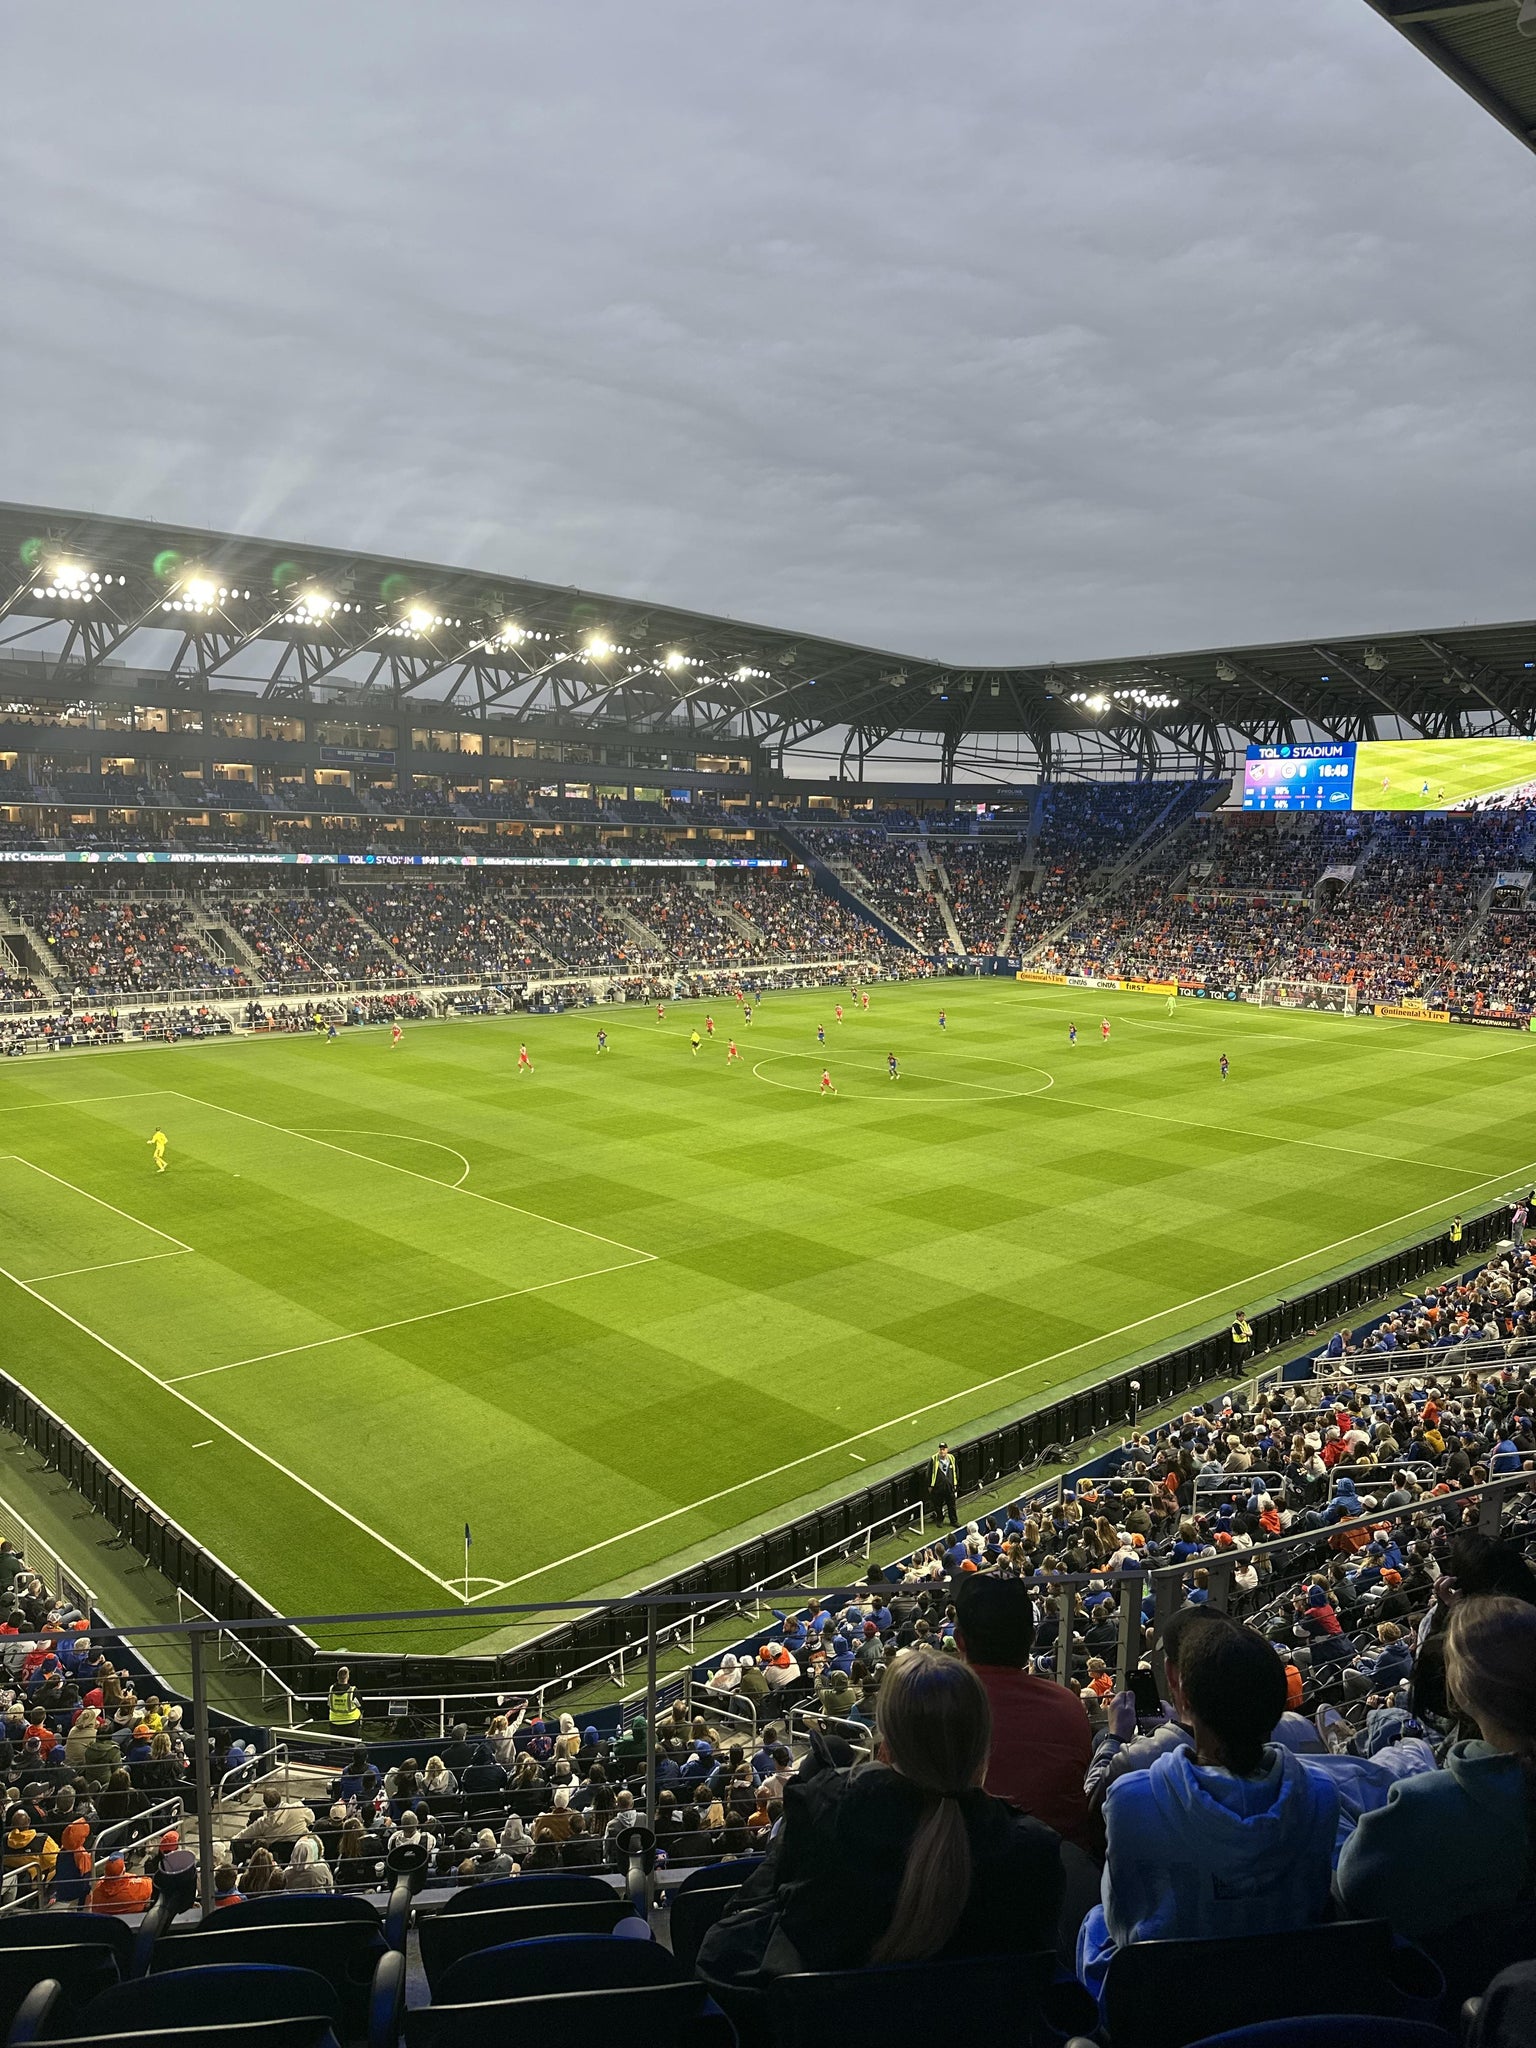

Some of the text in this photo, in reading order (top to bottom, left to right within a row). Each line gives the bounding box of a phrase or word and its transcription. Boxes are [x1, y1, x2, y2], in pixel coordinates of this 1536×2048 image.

[1259, 746, 1343, 758] TQL STADIUM
[5, 852, 20, 861] FC
[348, 855, 366, 864] TQL
[1179, 987, 1196, 997] TQL
[1209, 990, 1227, 1000] TQL
[1381, 1006, 1445, 1020] Continental Tire
[1472, 1018, 1511, 1027] POWERWASH
